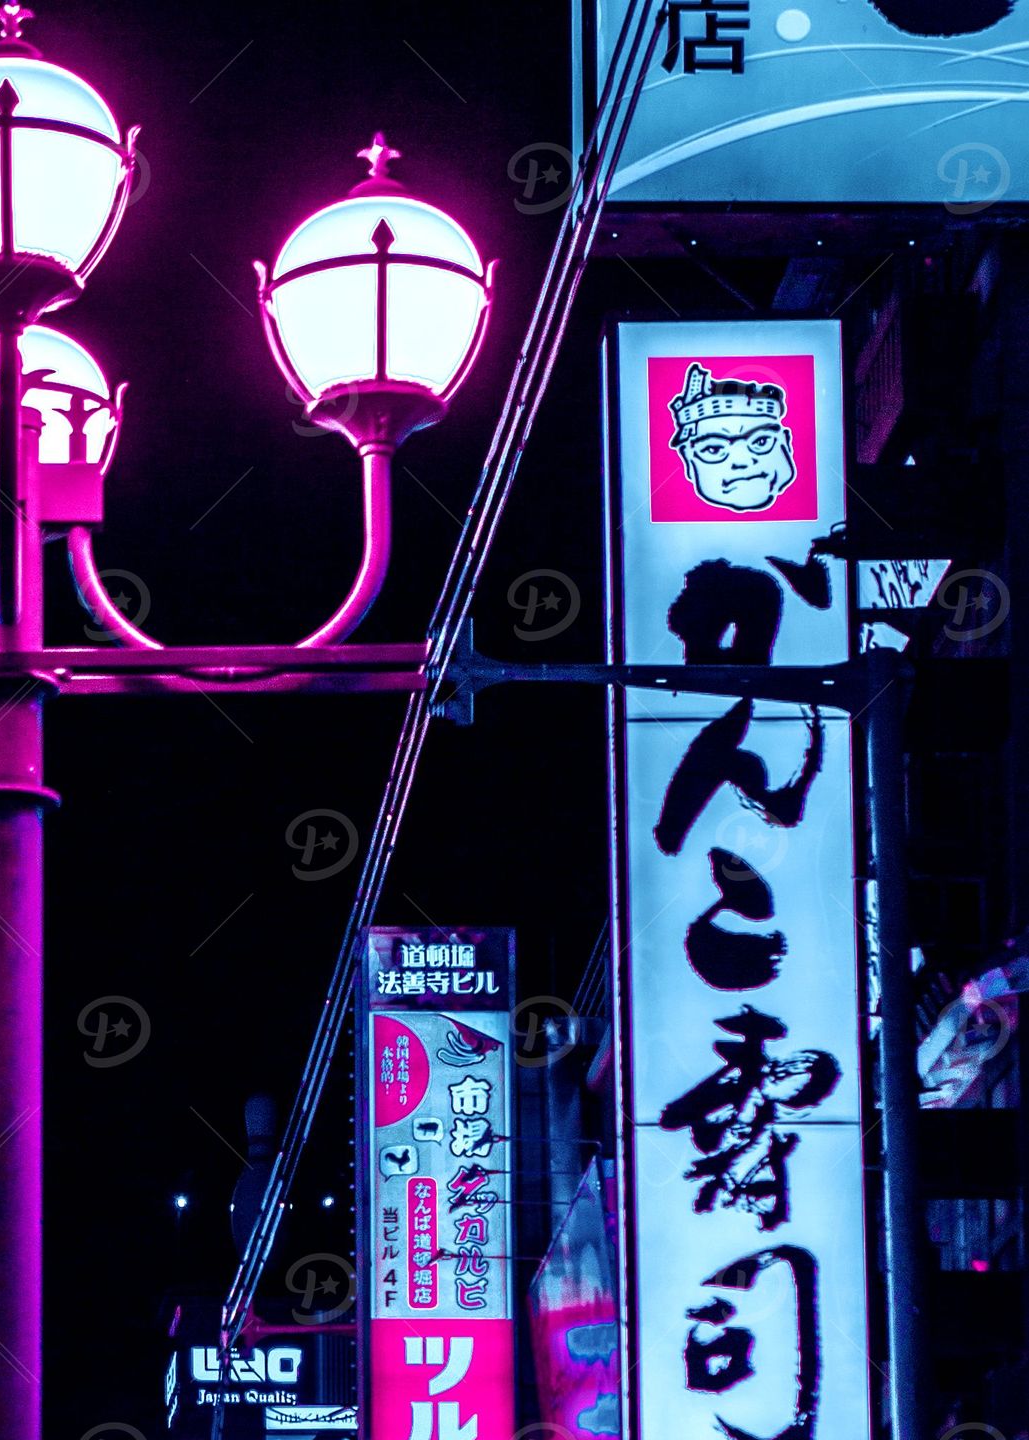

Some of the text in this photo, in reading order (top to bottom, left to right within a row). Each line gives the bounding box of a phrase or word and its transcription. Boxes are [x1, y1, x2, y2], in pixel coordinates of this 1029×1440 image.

[401, 944, 476, 968] 道頓堀
[377, 970, 500, 995] 法善寺ビル
[412, 1182, 434, 1305] なんば道頓堀店
[246, 1389, 297, 1405] Quality
